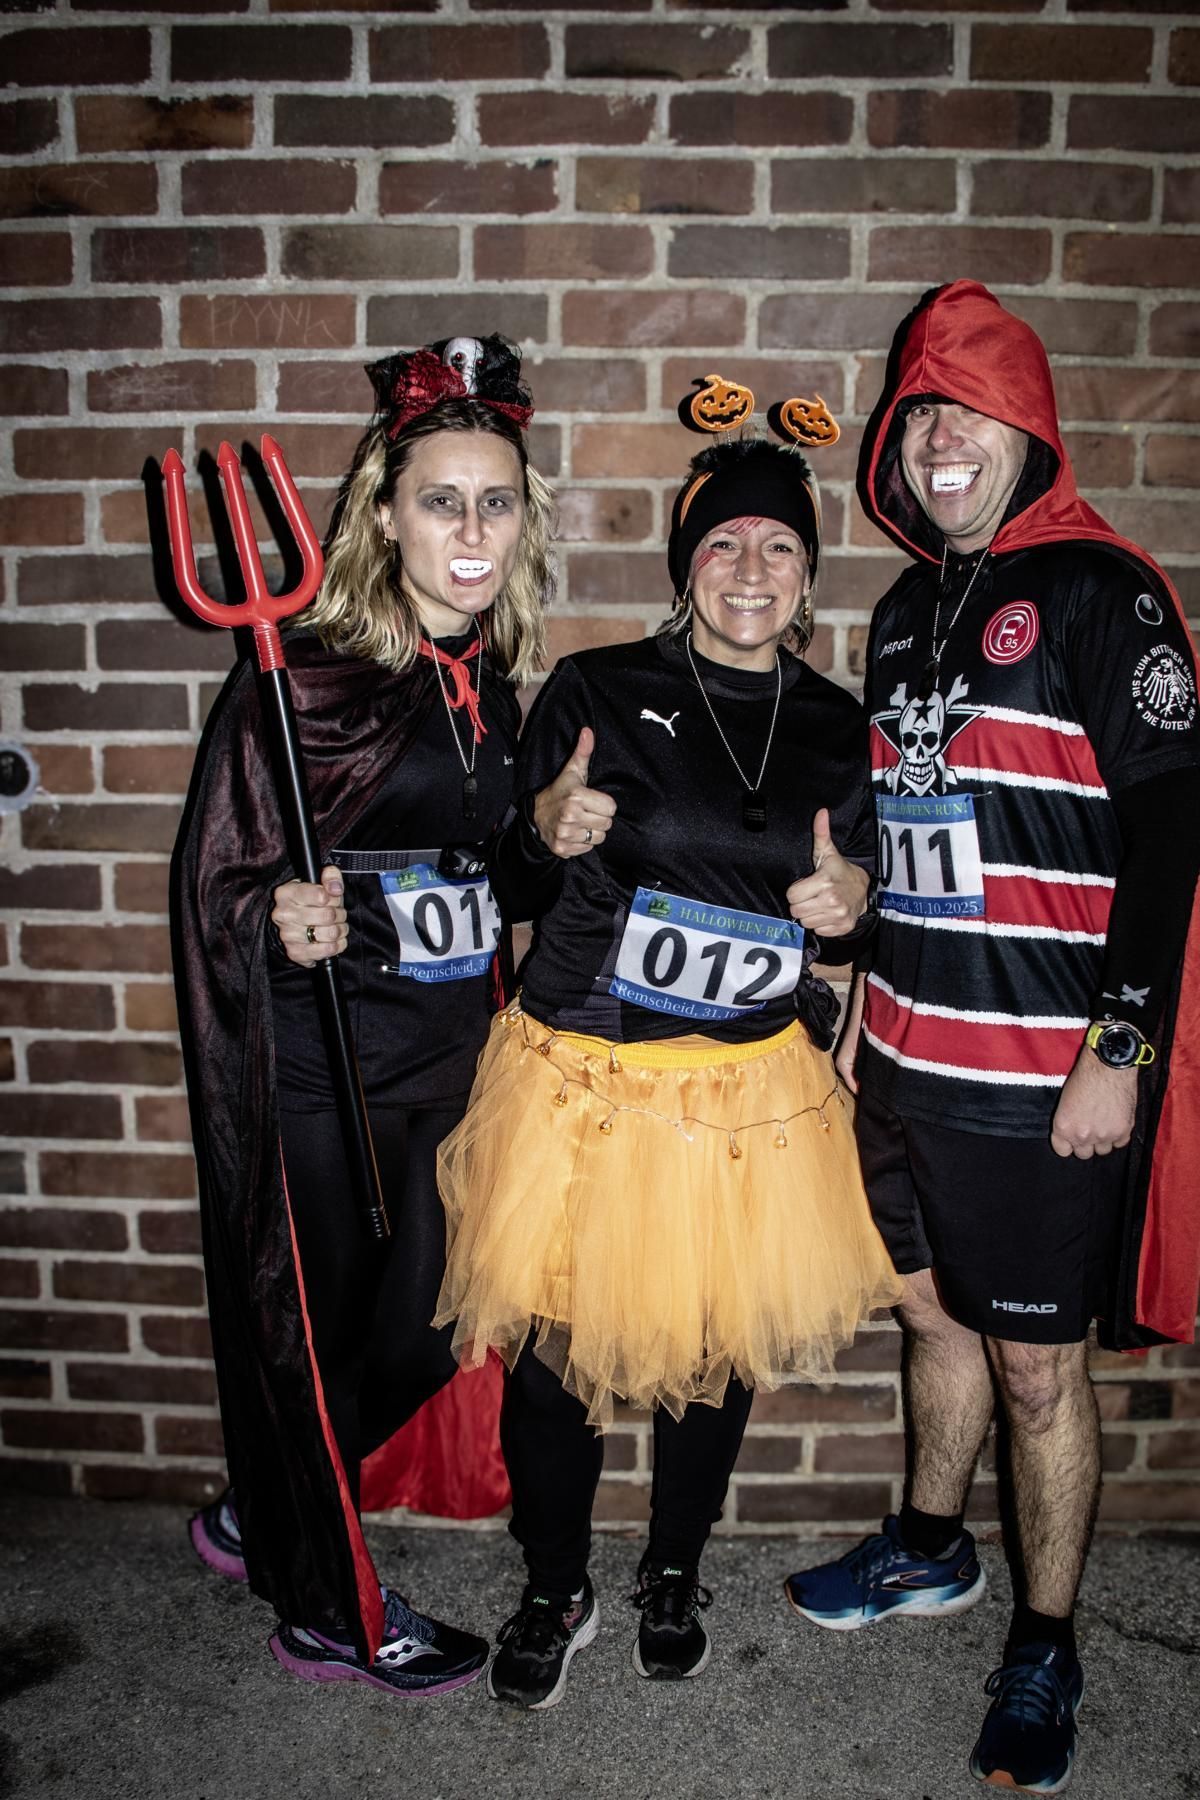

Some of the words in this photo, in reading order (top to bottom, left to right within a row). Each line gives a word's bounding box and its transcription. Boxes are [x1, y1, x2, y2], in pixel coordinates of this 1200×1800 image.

[1003, 637, 1019, 649] 95
[1133, 654, 1152, 678] ZUM
[1132, 680, 1141, 698] BIS
[1141, 710, 1159, 727] DIE
[1160, 720, 1191, 731] TOTEN
[880, 824, 957, 892] 011
[642, 927, 782, 1006] 012
[618, 983, 698, 1017] Remscheid,
[992, 1299, 1058, 1314] HEAD
